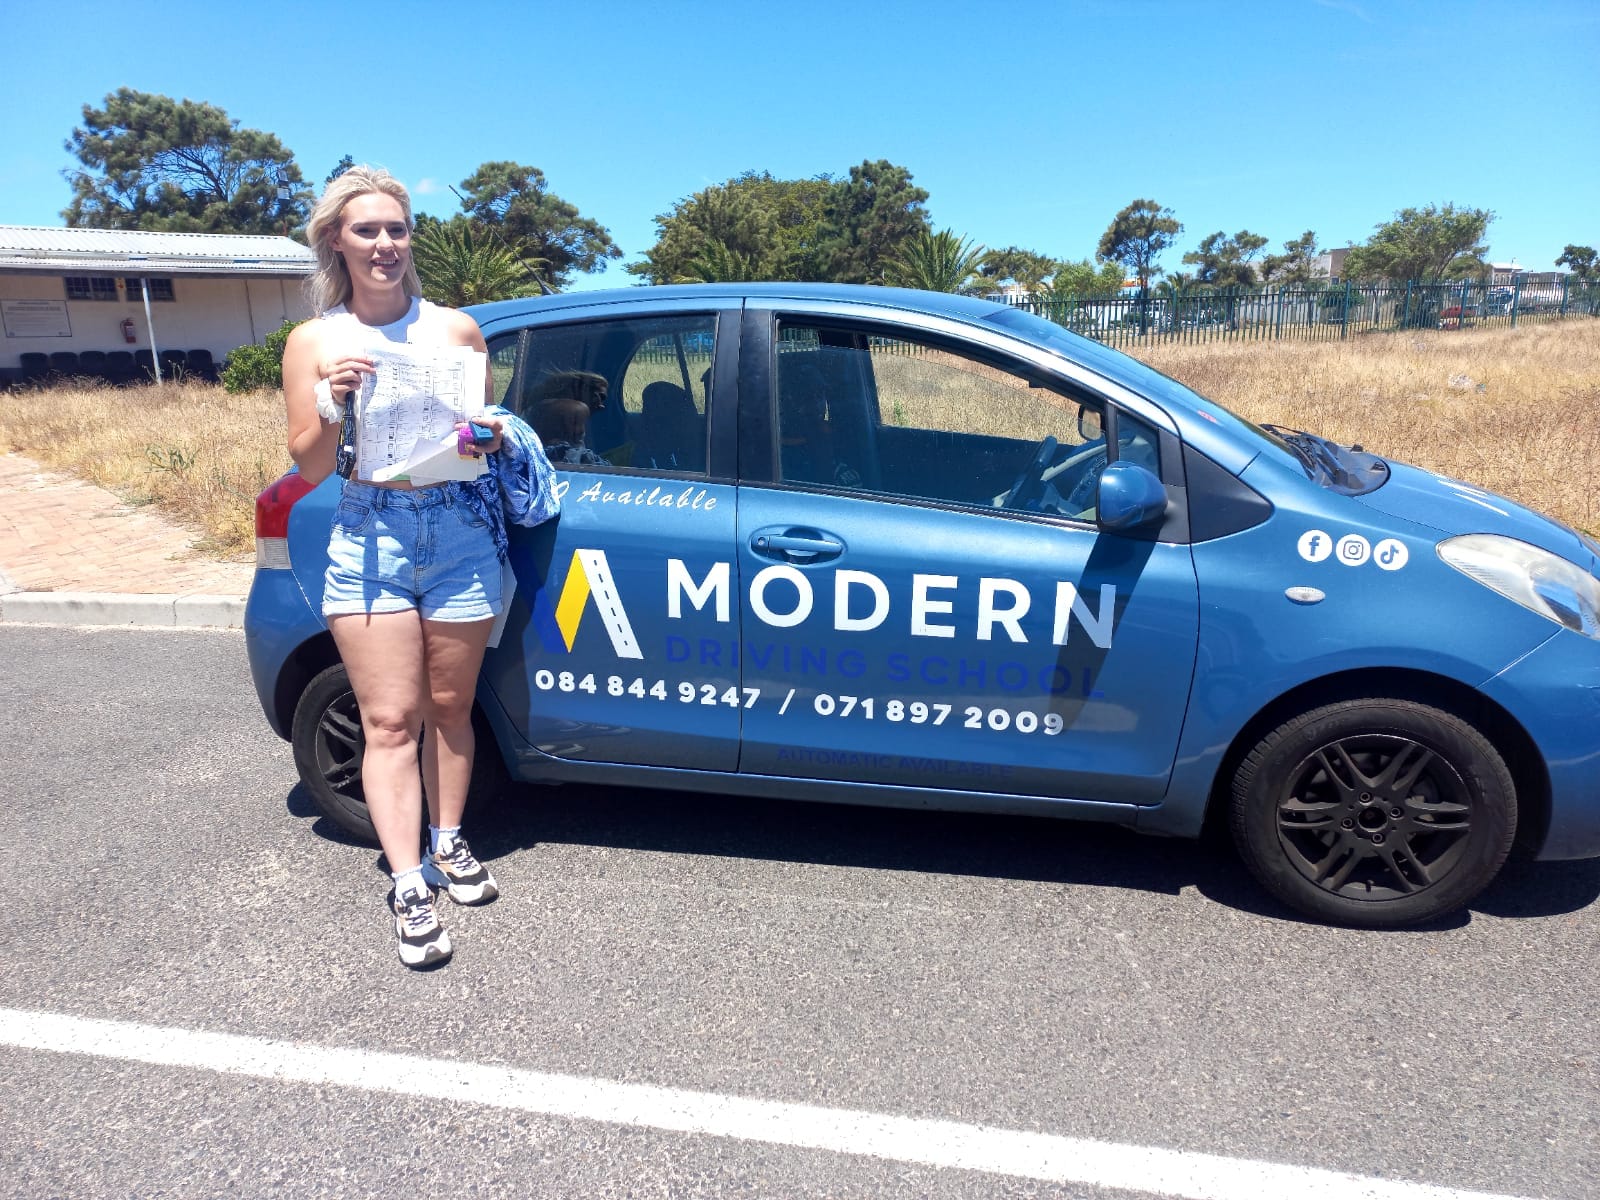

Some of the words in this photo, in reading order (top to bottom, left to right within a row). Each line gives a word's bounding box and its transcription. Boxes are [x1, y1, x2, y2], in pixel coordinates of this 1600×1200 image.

[576, 481, 718, 511] Available
[667, 558, 1117, 649] MODERN
[666, 634, 868, 679] DRIVING
[887, 653, 1105, 698] SCHOOL
[535, 669, 597, 694] 084
[607, 675, 667, 700] 844
[678, 682, 761, 709] 9247
[814, 693, 874, 720] 071
[886, 700, 952, 726] 897
[963, 706, 1064, 736] 2009
[777, 747, 892, 769] AUTOMATIC
[898, 757, 1015, 778] AVAILABLE
